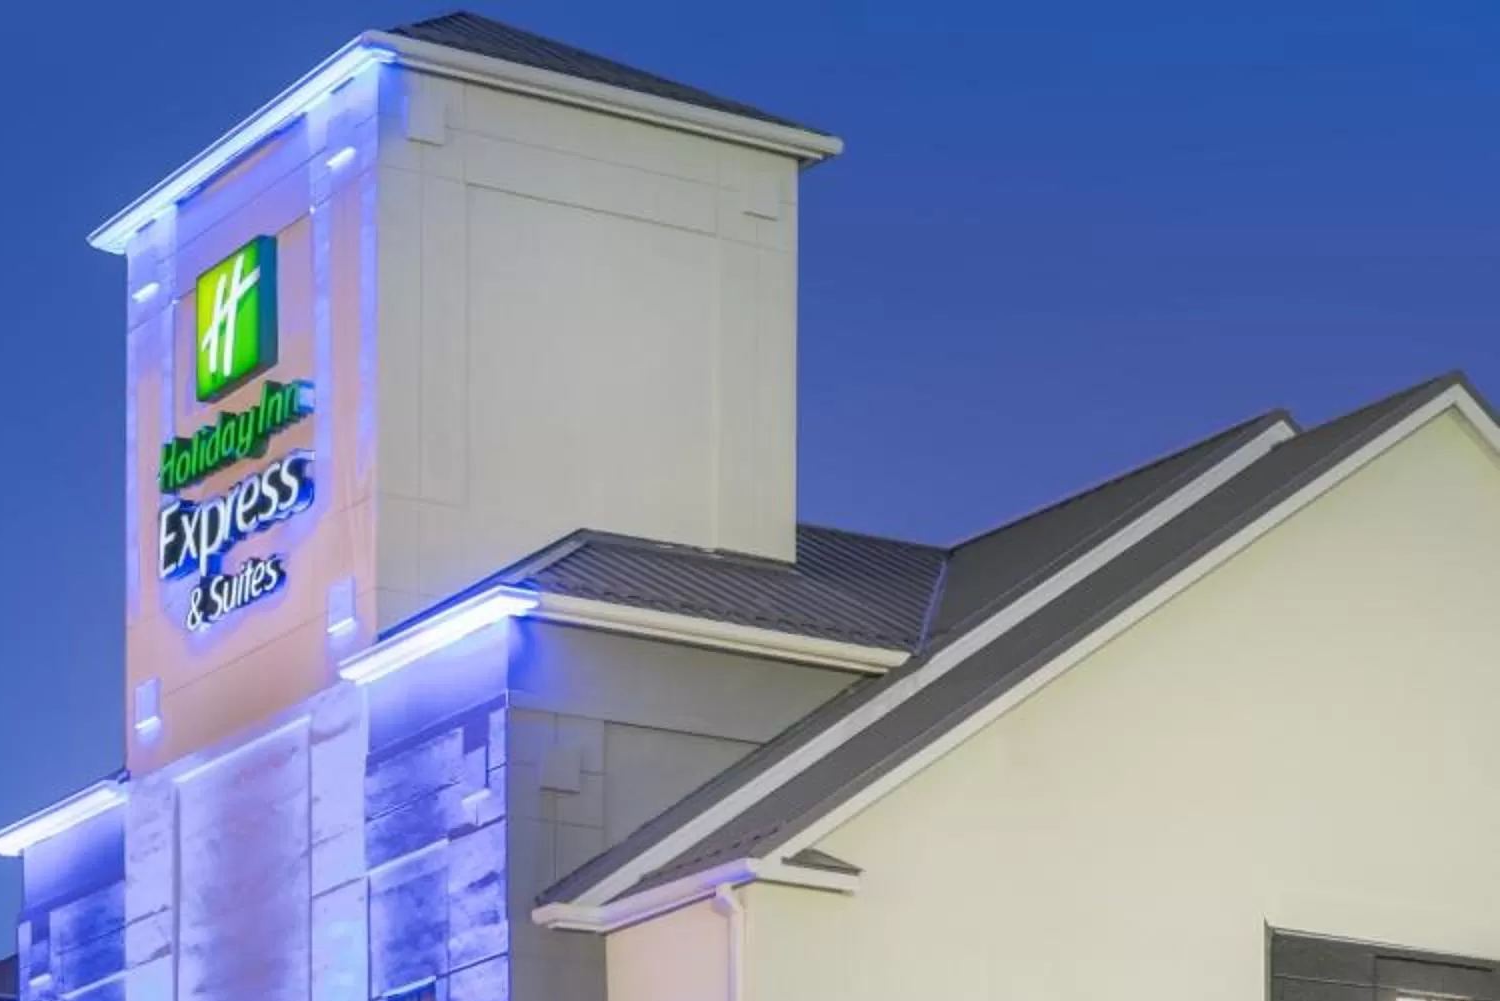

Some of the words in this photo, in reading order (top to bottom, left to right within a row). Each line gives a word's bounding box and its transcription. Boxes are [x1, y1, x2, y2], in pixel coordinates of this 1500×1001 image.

[159, 408, 256, 489] Holiday
[257, 380, 301, 434] Inn
[159, 455, 302, 579] Express
[186, 587, 203, 631] &
[207, 556, 279, 621] Suites
